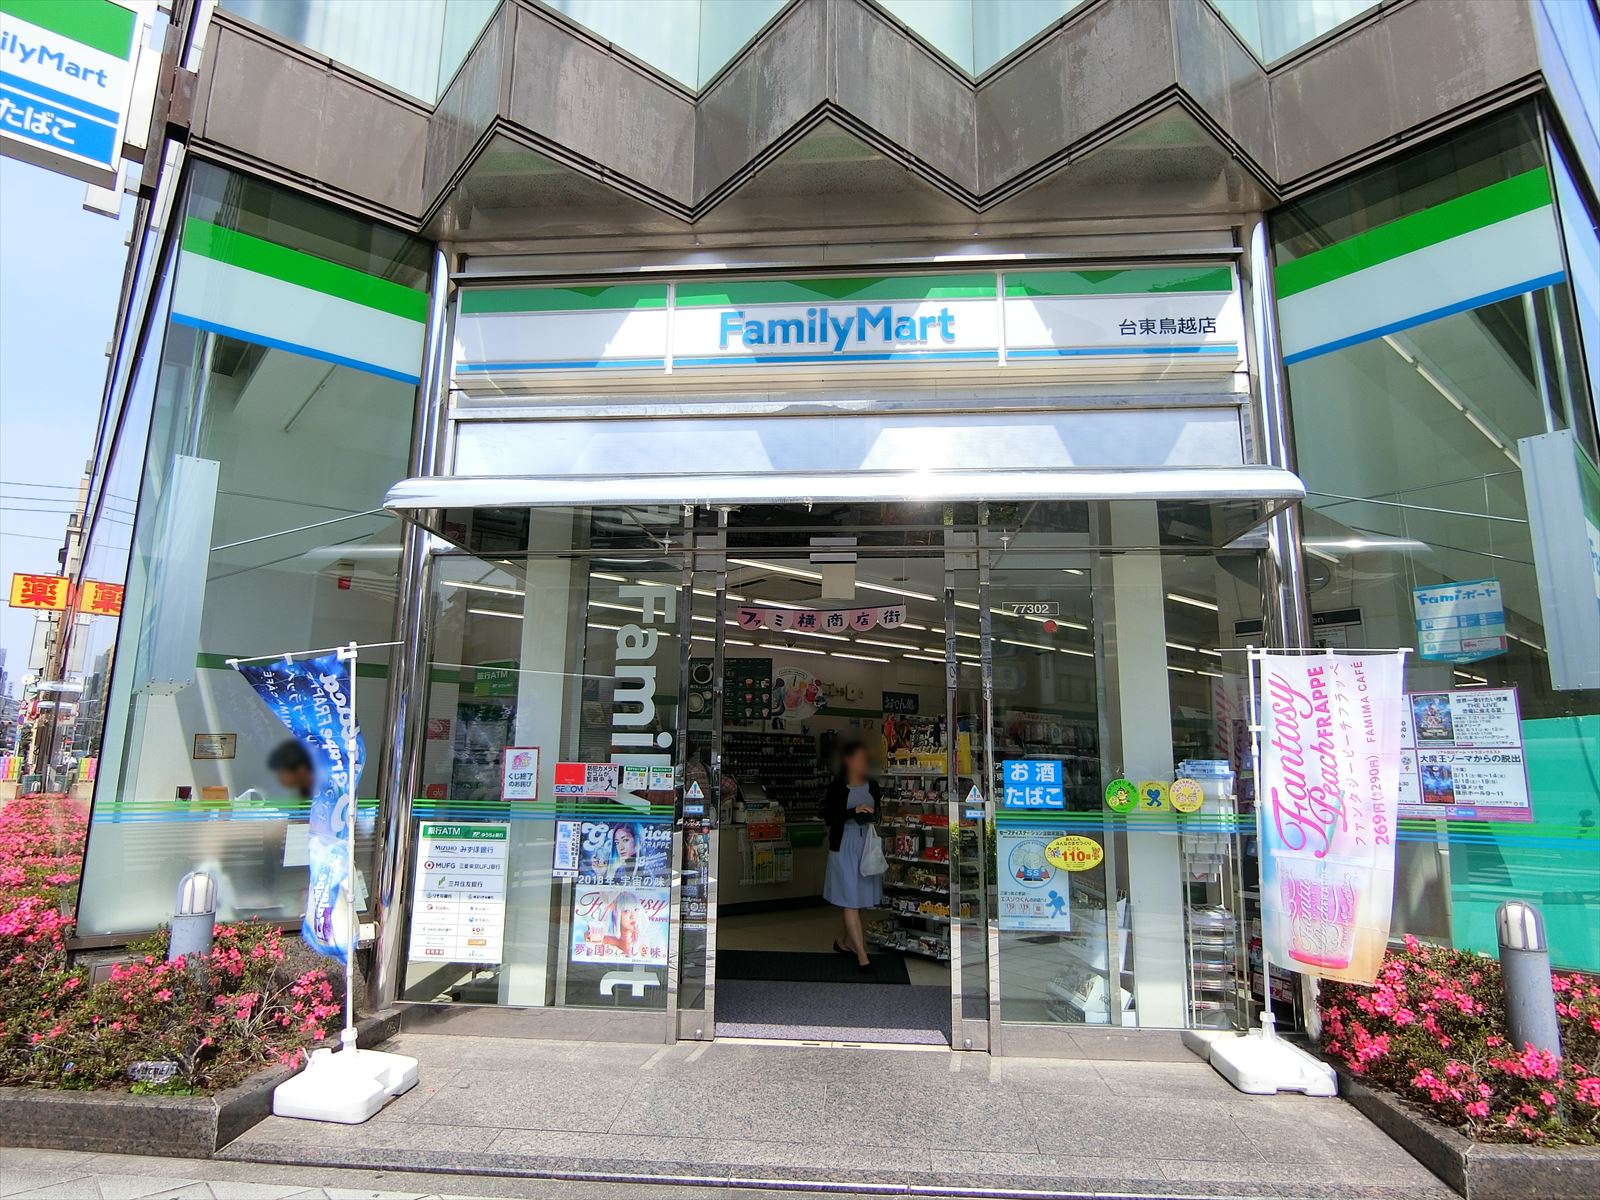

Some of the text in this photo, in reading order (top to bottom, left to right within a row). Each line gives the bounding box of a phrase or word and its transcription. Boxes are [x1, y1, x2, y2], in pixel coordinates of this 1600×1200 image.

[718, 306, 955, 353] FamilyMart
[1118, 317, 1216, 336] 台東鳥越店
[21, 576, 59, 606] 薬
[740, 609, 901, 628] ファミ横商店街
[1011, 604, 1050, 614] 77302
[1350, 660, 1376, 743] FAMIMA CAFÉ
[1307, 665, 1347, 832] Peach FRAPPE
[1269, 672, 1328, 857] Fantasy
[1420, 754, 1521, 763] 大魔王ゾーマからの脱出
[508, 772, 534, 780] くじ終了
[1010, 763, 1055, 782] お酒
[555, 785, 584, 794] SECOM
[1006, 787, 1063, 806] たばこ
[427, 827, 461, 836] 銀行ATM
[460, 845, 494, 854] みずほ銀行
